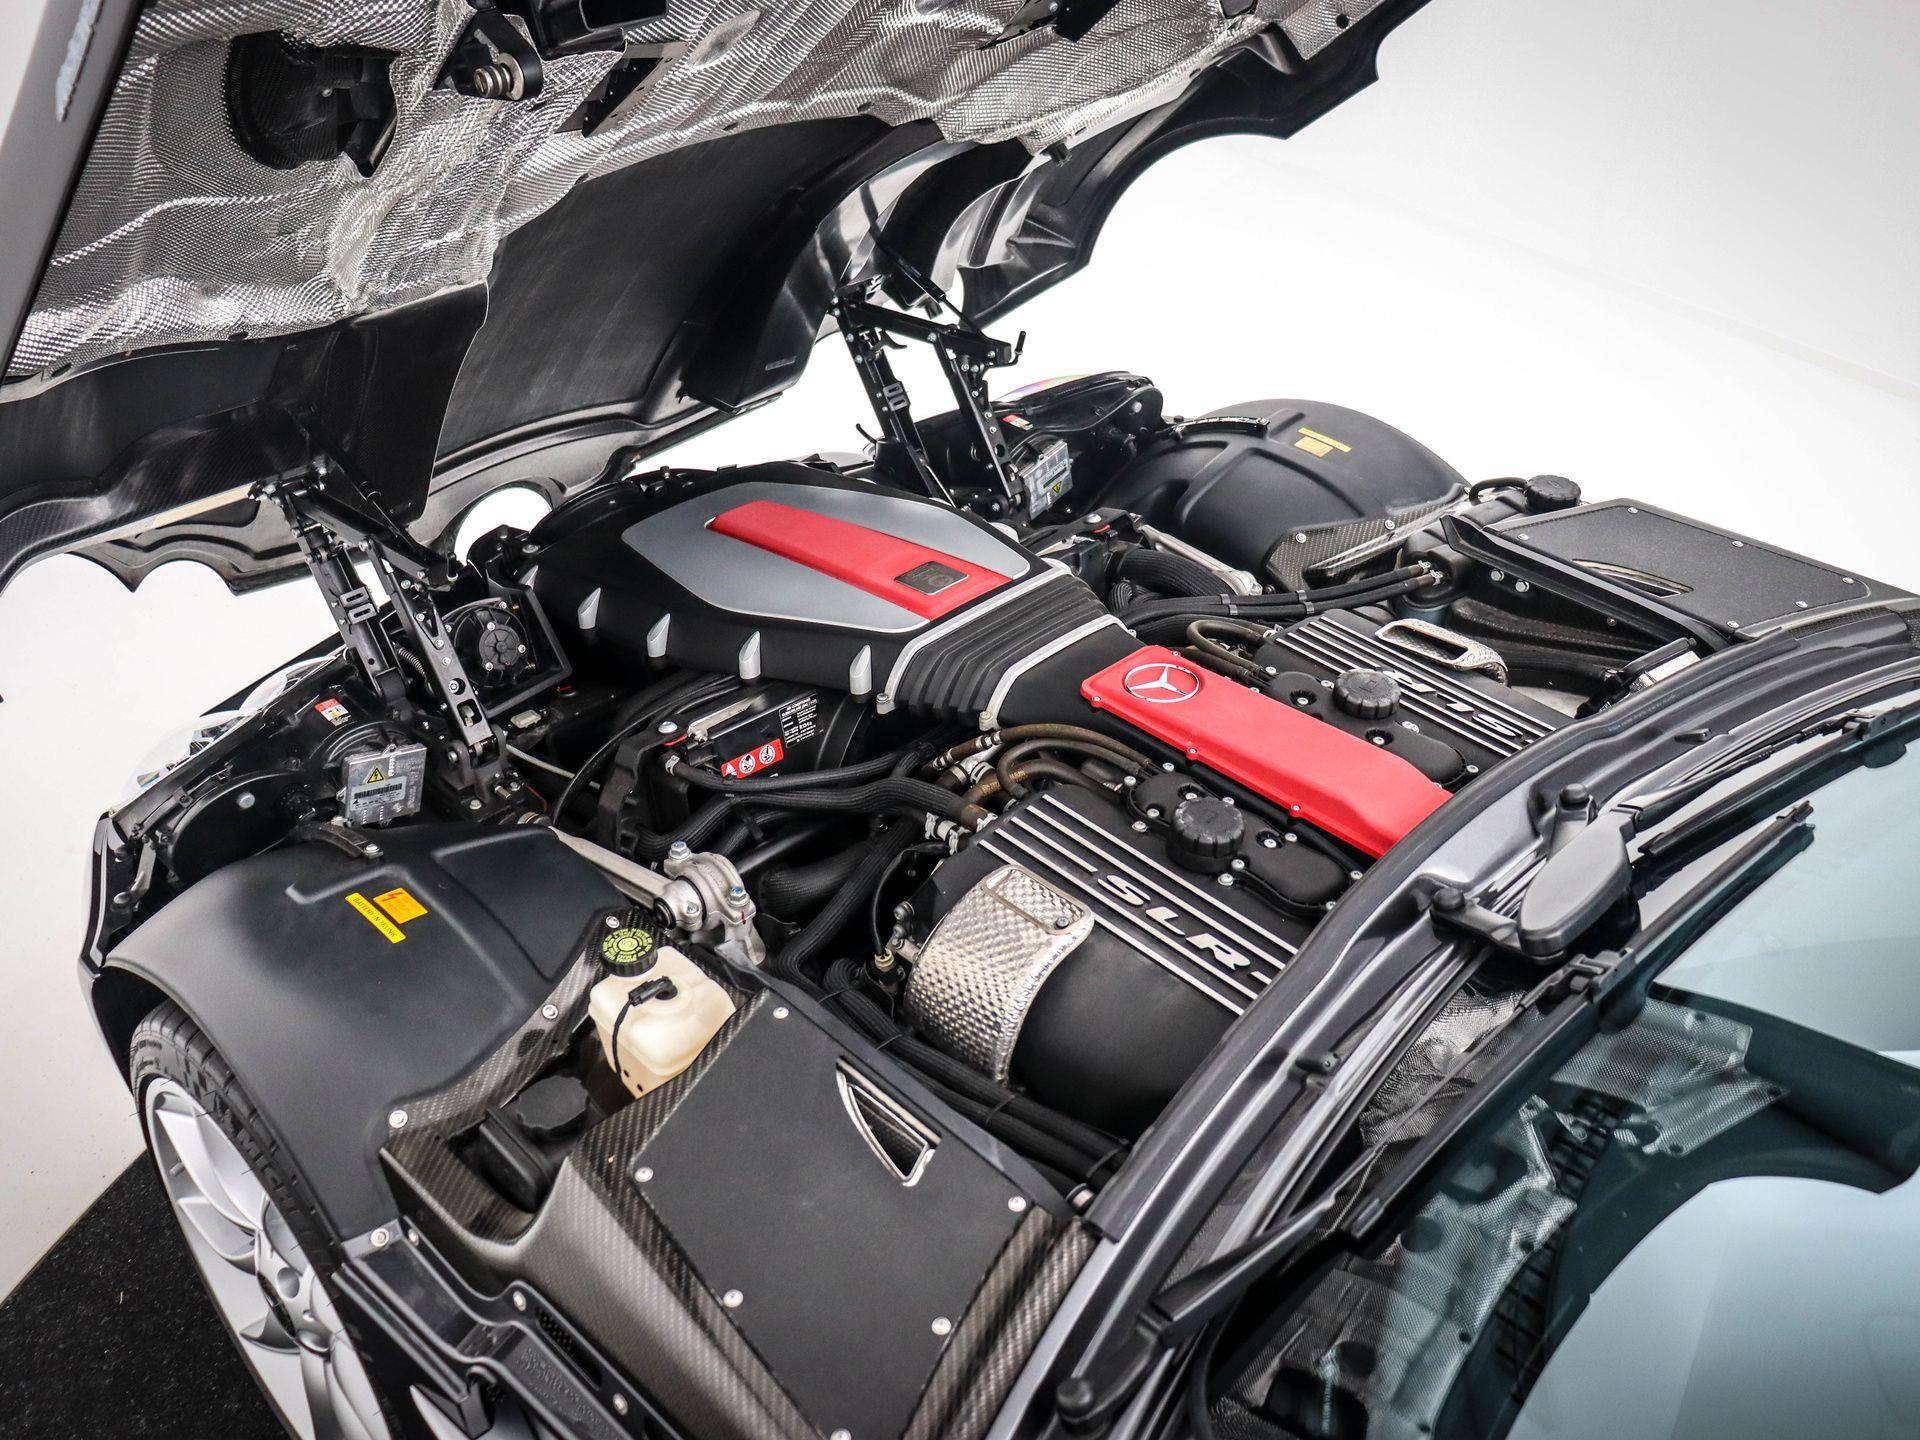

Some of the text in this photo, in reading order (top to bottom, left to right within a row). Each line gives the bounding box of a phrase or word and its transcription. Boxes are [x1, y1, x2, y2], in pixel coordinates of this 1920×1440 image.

[1383, 670, 1523, 737] SLR
[353, 897, 374, 916] BATTERY
[380, 921, 396, 938] TRUNK
[1097, 874, 1251, 970] SLR
